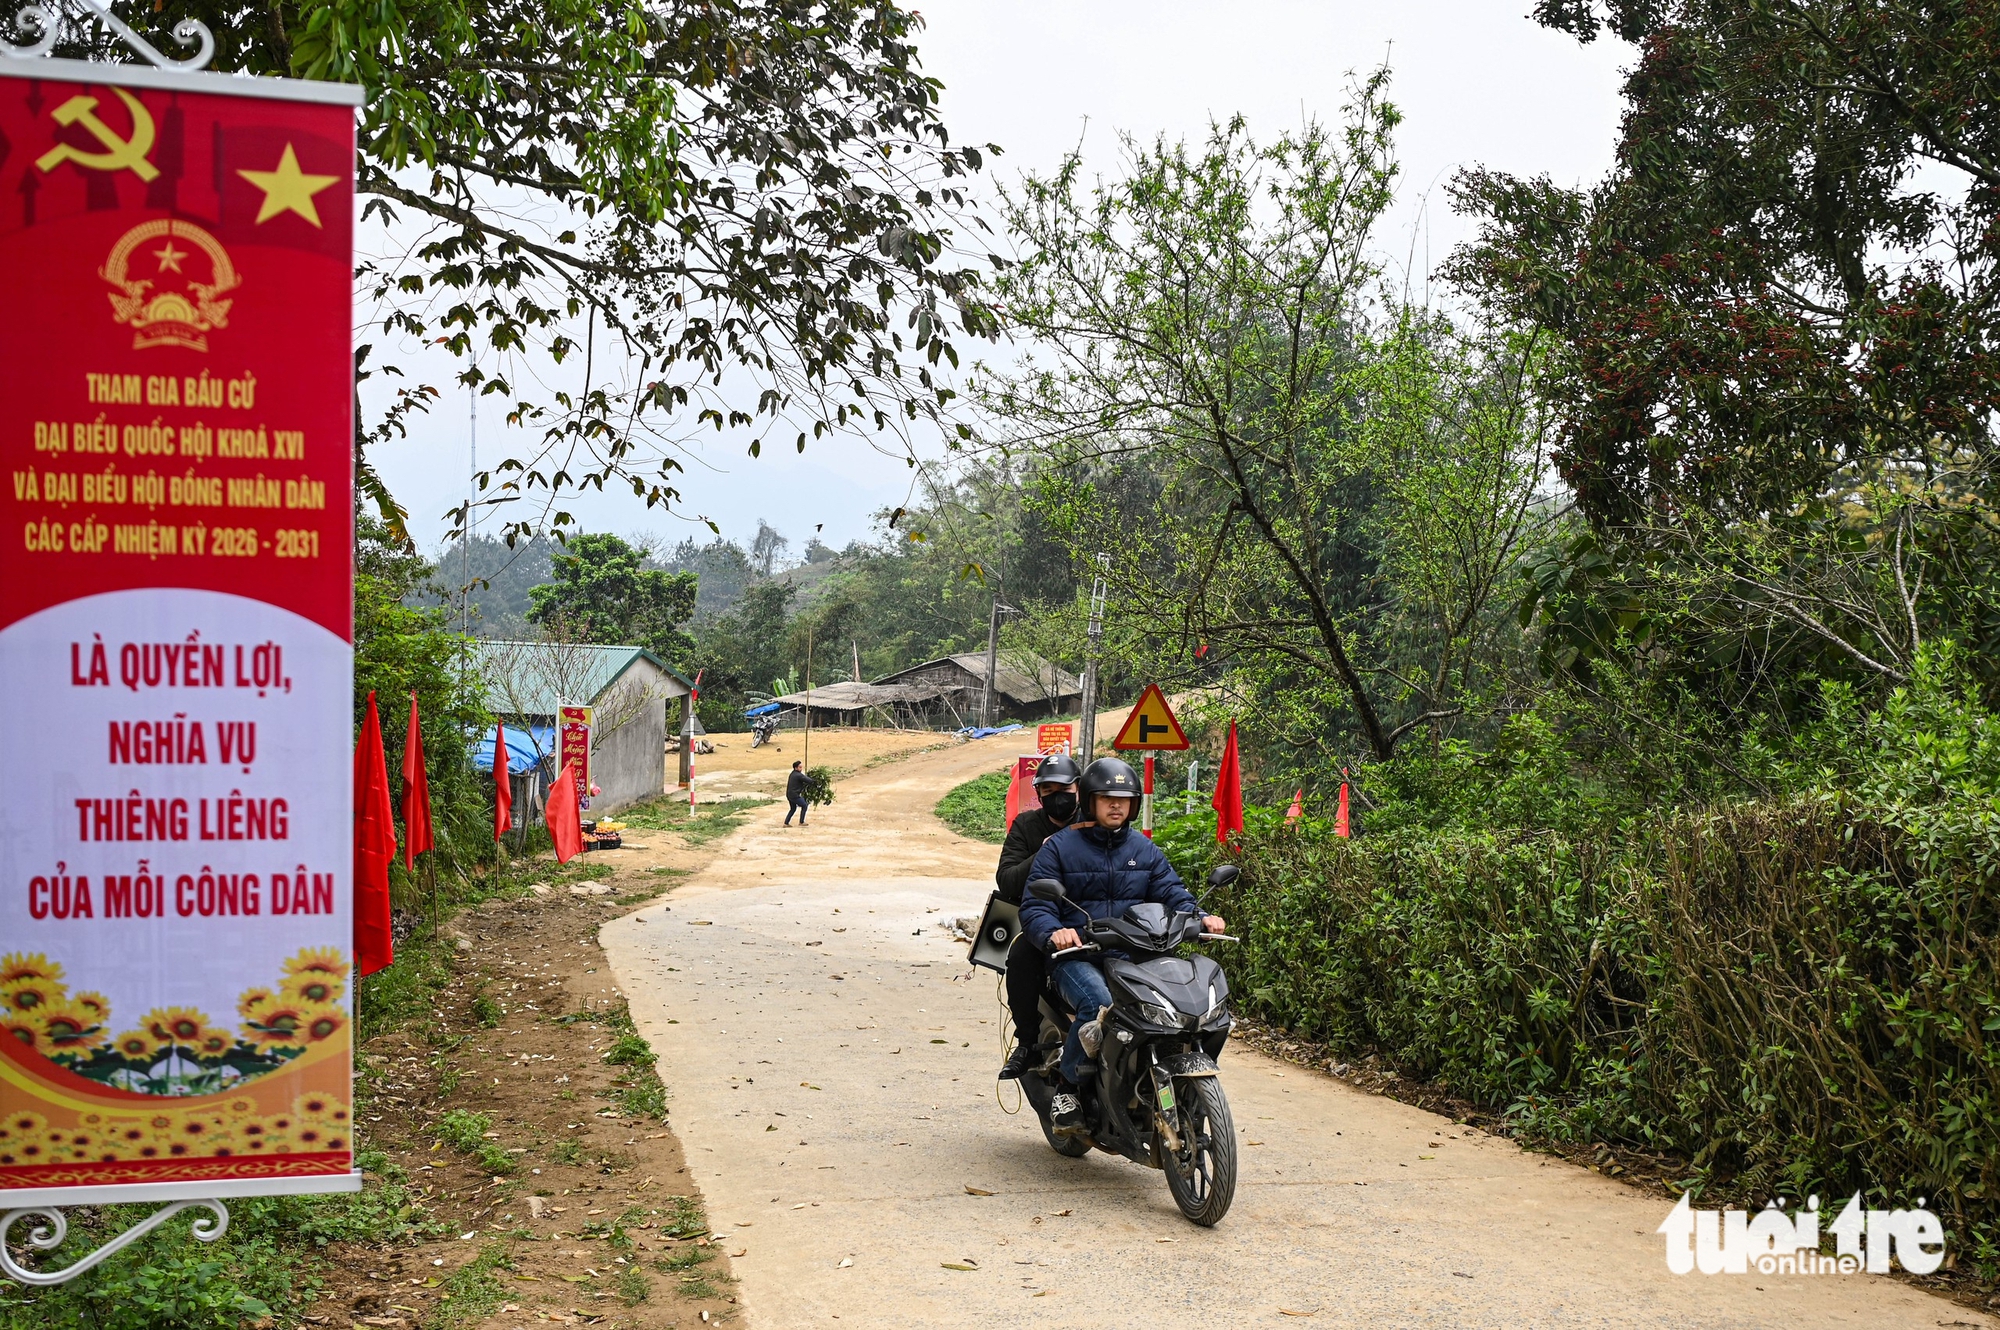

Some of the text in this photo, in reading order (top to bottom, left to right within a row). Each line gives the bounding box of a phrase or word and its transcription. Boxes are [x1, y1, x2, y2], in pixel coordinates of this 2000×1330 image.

[87, 369, 256, 408] THAM GIA BẦU CỬ
[35, 422, 67, 457] ĐẠI
[74, 413, 117, 453] BIỂU
[124, 418, 174, 456] QUỐC
[181, 422, 212, 462] HỘI
[274, 431, 304, 459] XVI
[14, 464, 324, 510] VÀ ĐẠI BIỂU HỘI ĐỒNG NHÂN DÂN
[25, 517, 63, 551] CÁC
[70, 515, 108, 552] CẤP
[115, 520, 176, 559] NHIỆM
[183, 521, 206, 554] KỲ
[212, 528, 257, 556] 2026
[276, 530, 318, 557] 2031
[71, 630, 291, 697] LÀ QUYỀN LỢI,
[109, 713, 255, 774] NGHĨA VỤ
[75, 789, 288, 841] THIÊNG LIÊNG
[29, 859, 333, 920] CỦA MỖI CÔNG DÂN
